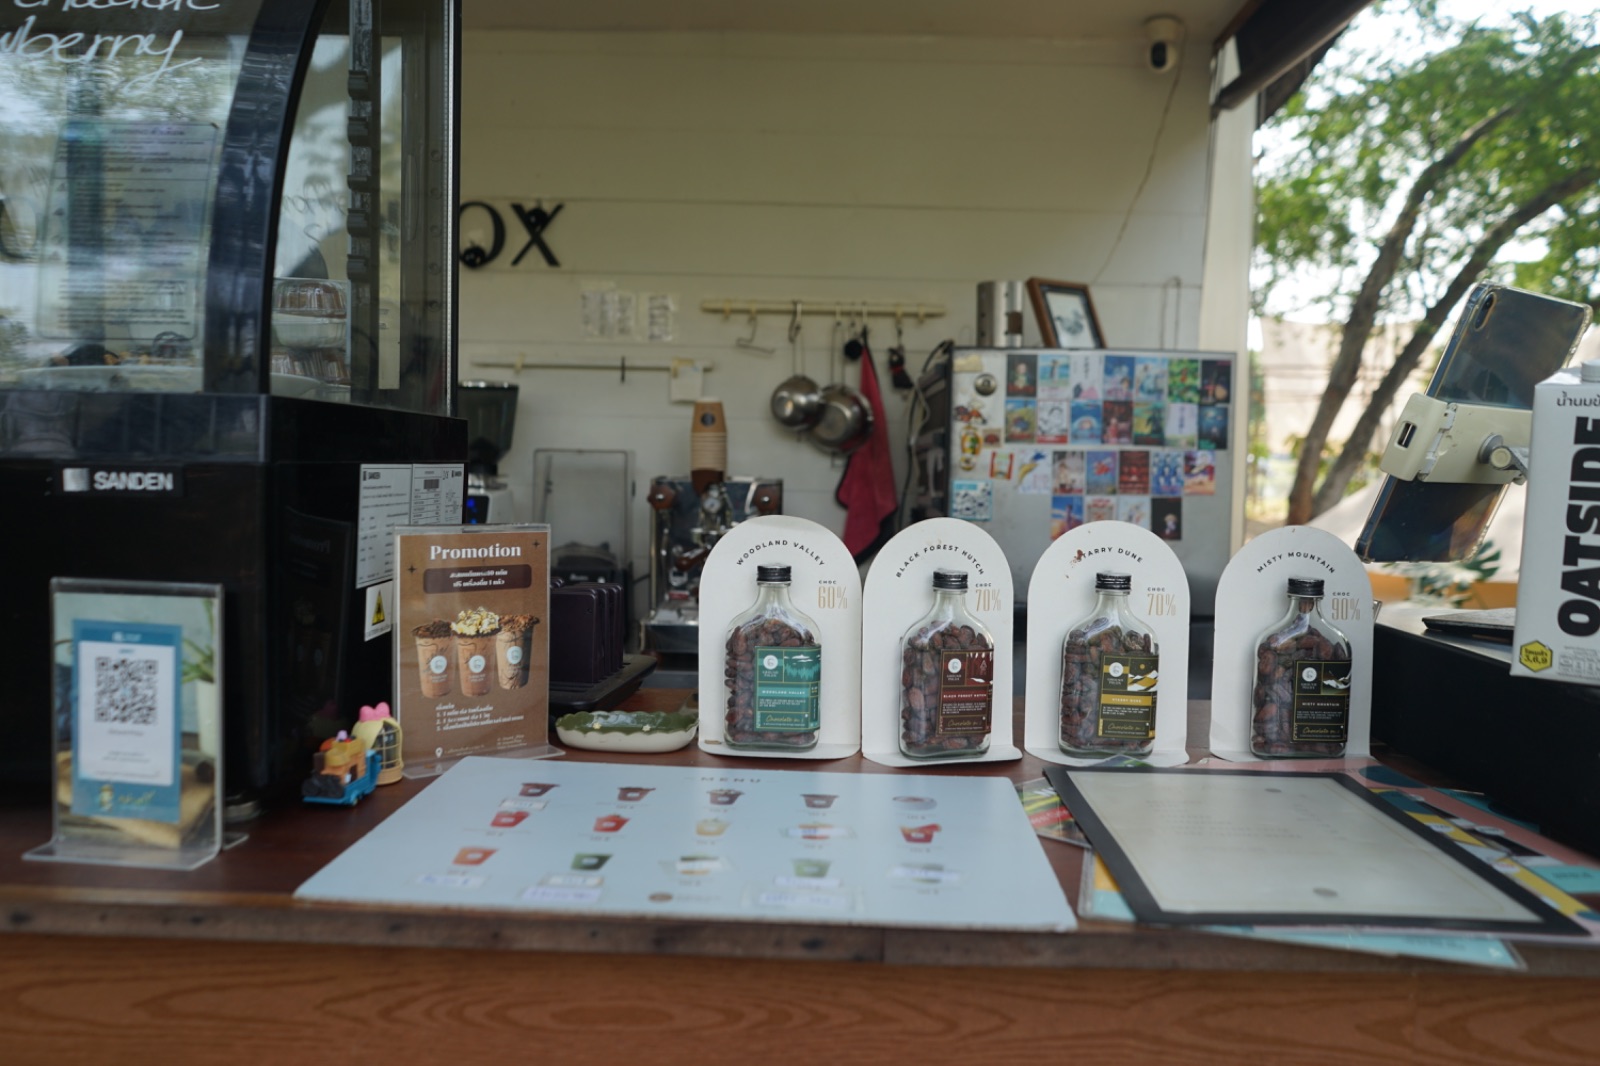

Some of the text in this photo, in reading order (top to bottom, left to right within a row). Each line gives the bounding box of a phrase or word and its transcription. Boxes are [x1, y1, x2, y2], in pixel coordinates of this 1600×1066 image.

[93, 471, 173, 491] SANDEN
[430, 543, 521, 561] Promotion
[736, 539, 825, 567] WOODLAND VALLEY
[895, 544, 984, 578] BLACK FOREST HUTCH
[1117, 547, 1143, 563] DUNE
[1256, 551, 1336, 574] MISTY MOUNTAIN
[818, 586, 848, 609] 60%
[975, 589, 1001, 611] 70%
[1147, 594, 1176, 616] 70%
[1331, 597, 1360, 620] 90%
